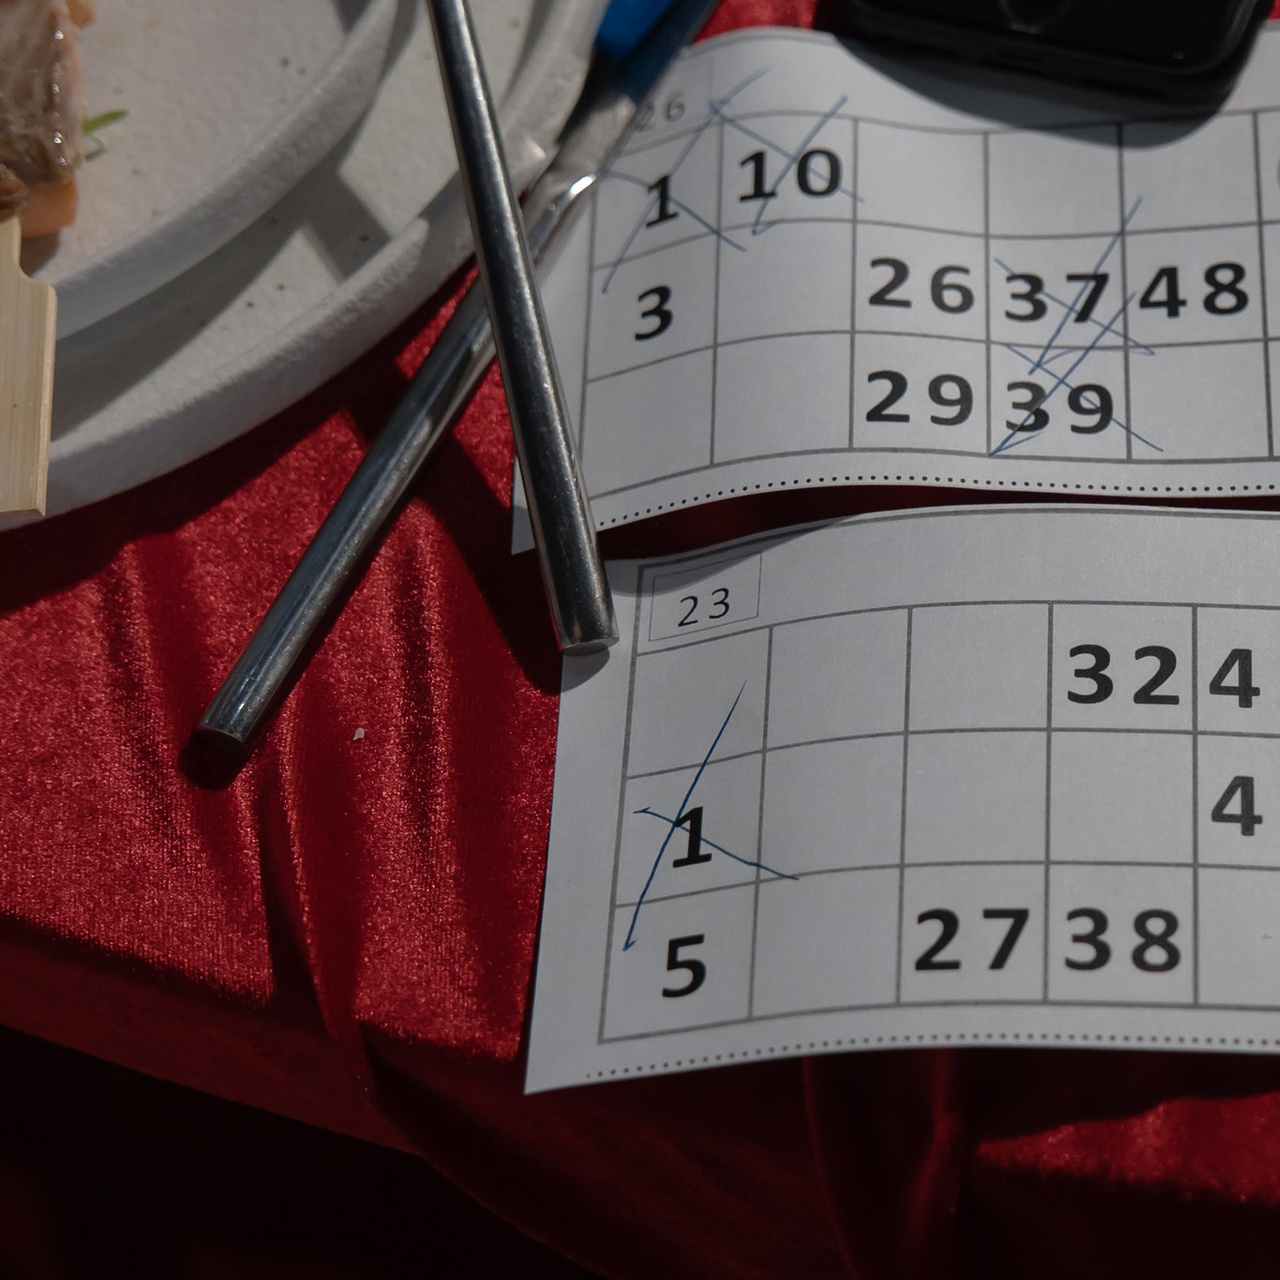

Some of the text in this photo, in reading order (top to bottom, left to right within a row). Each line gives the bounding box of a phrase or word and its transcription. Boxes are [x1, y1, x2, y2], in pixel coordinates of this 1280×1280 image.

[645, 175, 678, 228] 1
[738, 149, 842, 202] 10
[634, 286, 673, 341] 3
[869, 257, 974, 314] 26
[1006, 272, 1109, 324] 37
[1139, 261, 1251, 317] 48
[866, 370, 973, 426] 29
[1006, 381, 1113, 434] 39
[678, 587, 730, 626] 23
[1067, 645, 1180, 706] 32
[672, 807, 711, 867] 1
[661, 934, 707, 997] 5
[915, 908, 1030, 971] 27
[1064, 908, 1180, 972] 38
